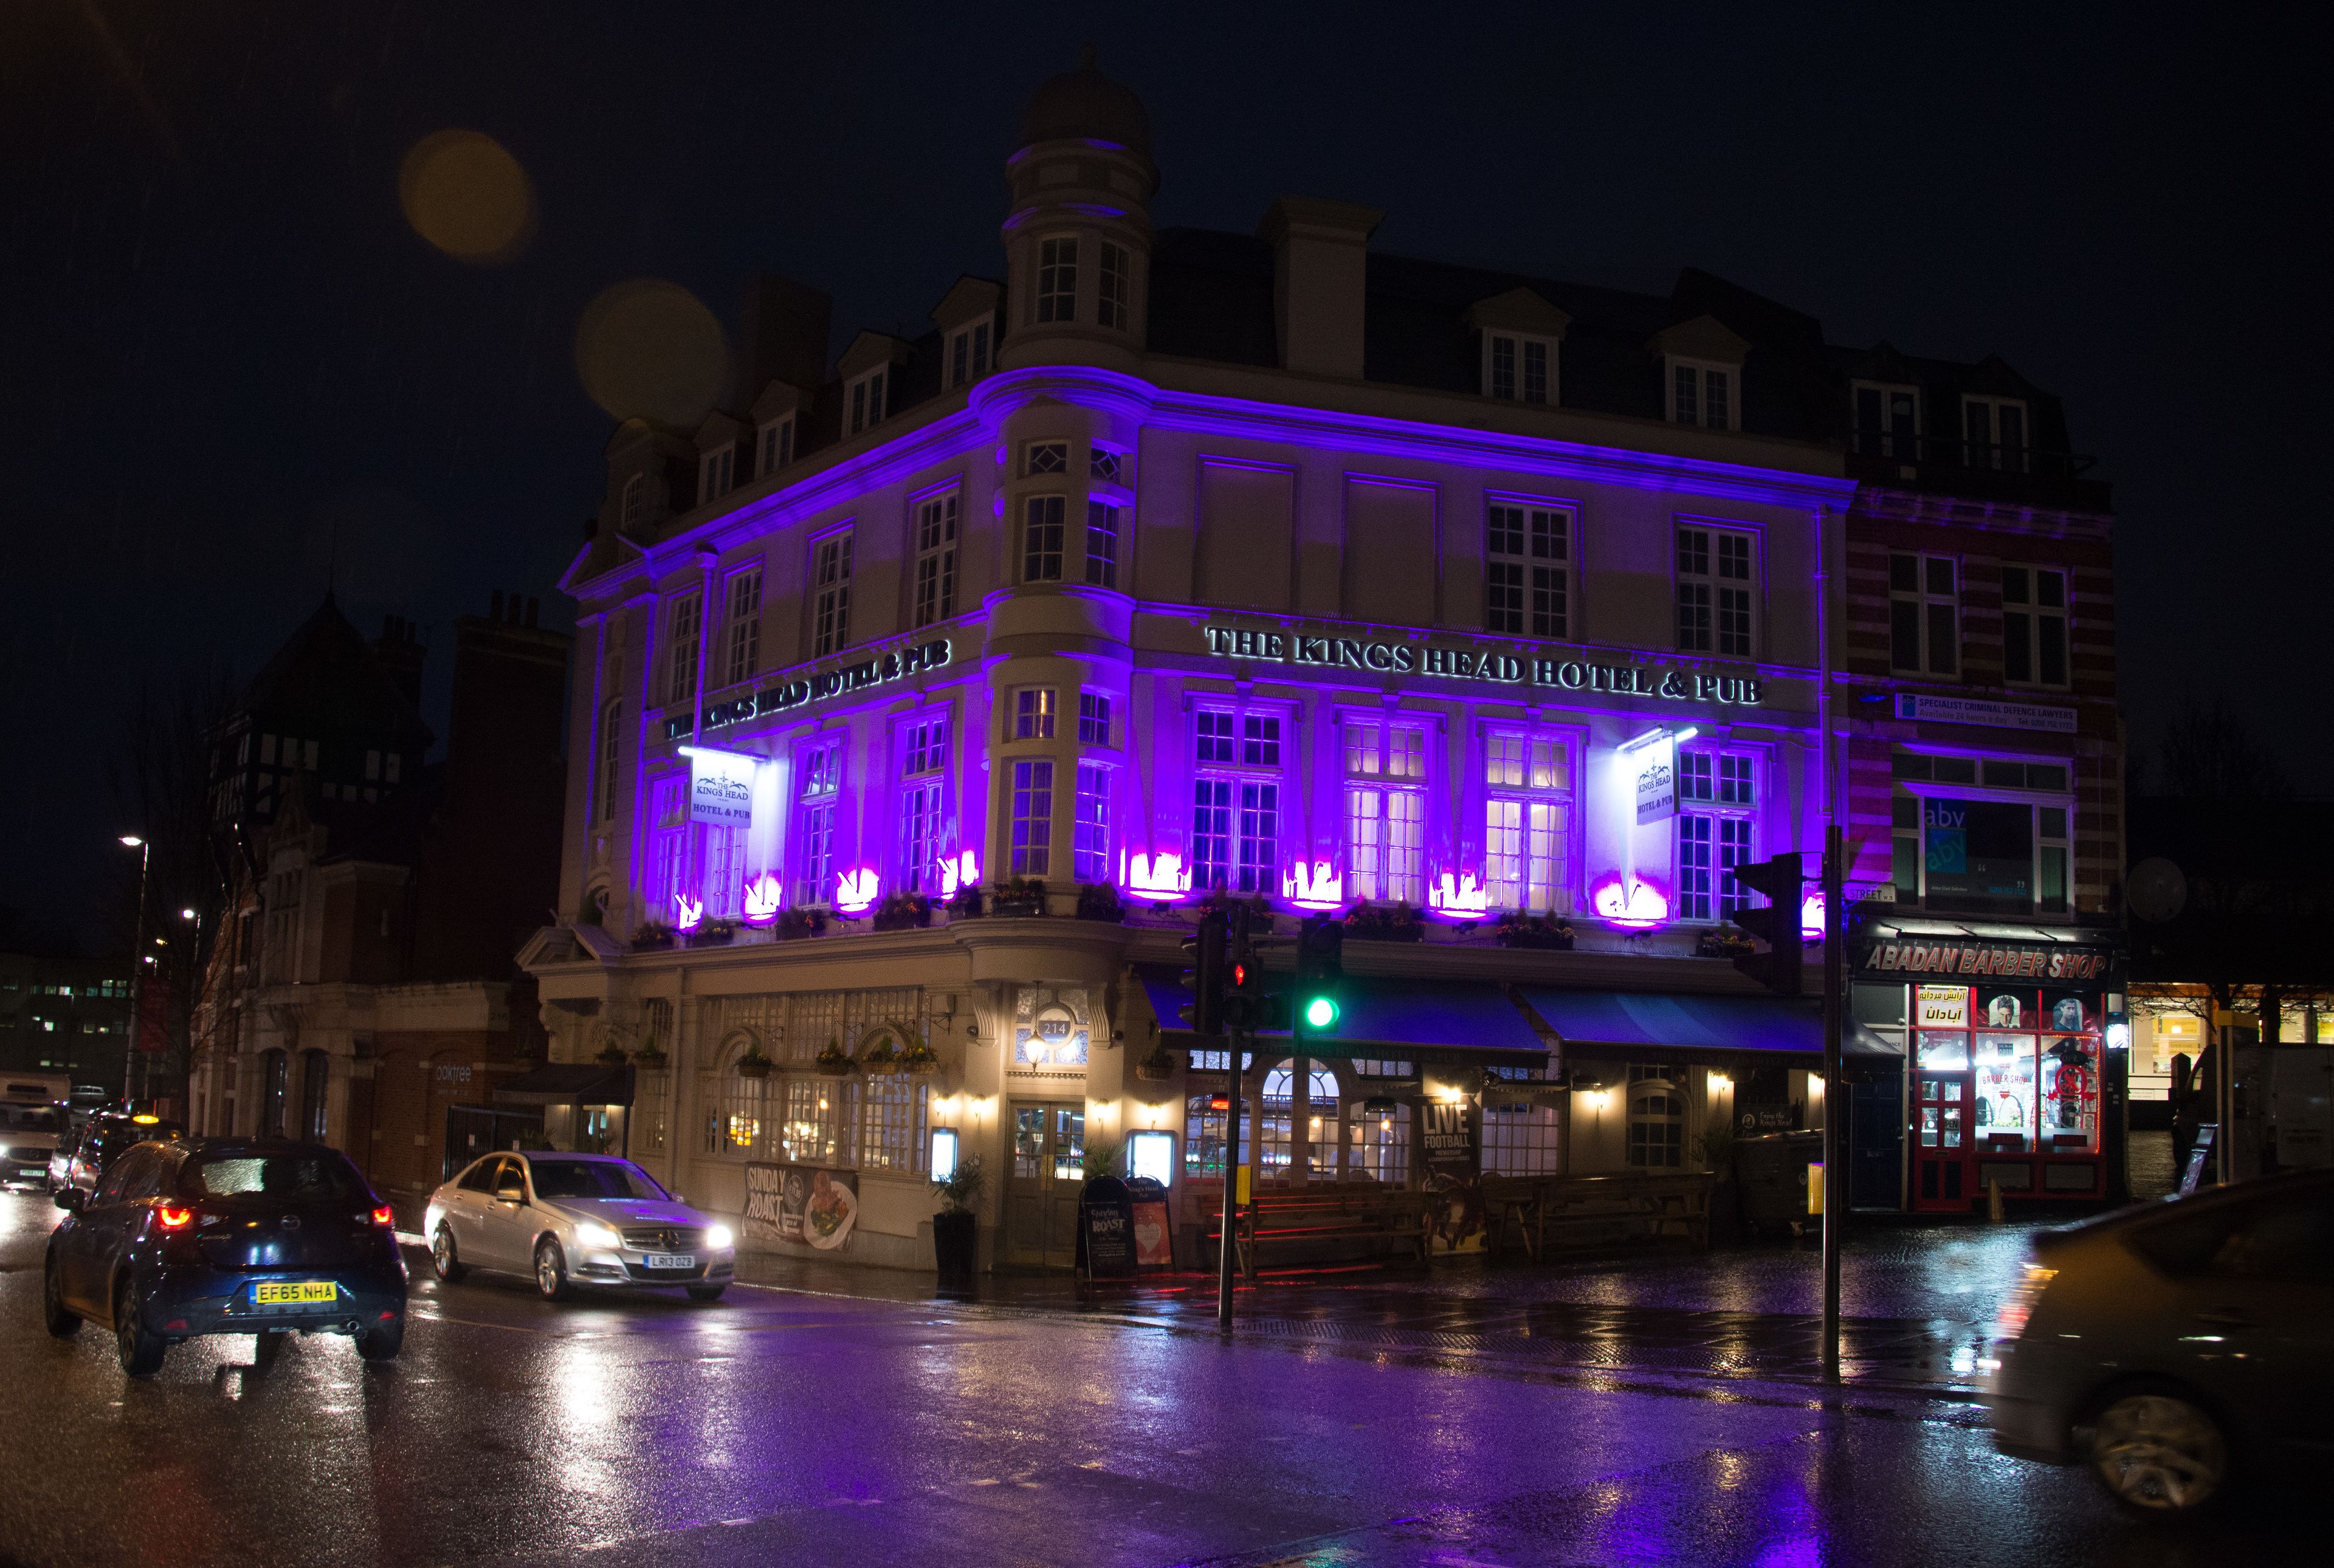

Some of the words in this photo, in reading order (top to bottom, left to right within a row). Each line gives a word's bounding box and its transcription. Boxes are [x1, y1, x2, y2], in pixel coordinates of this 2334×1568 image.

[881, 653, 902, 681] &
[903, 638, 952, 675] PUB
[1206, 625, 1285, 661] THE
[1295, 634, 1415, 672] KINGS
[1422, 647, 1527, 683] HEAD
[1534, 658, 1656, 696] HOTEL
[1661, 670, 1689, 698] &
[1695, 673, 1764, 705] PUB
[1919, 698, 1962, 710] SPECIALIST
[1964, 702, 2002, 714] CRIMINAL
[2003, 706, 2036, 717] DEFENCE
[2038, 710, 2073, 720] LAWYERS
[1919, 709, 1954, 720] Available
[1956, 712, 1964, 720] 24
[697, 786, 723, 797] KINGS
[725, 790, 748, 800] HEAD
[1639, 780, 1654, 793] KINGS
[1656, 775, 1671, 788] HEAD
[693, 803, 722, 816] HOTEL
[725, 808, 731, 816] &
[734, 810, 750, 819] PUB
[1637, 802, 1656, 814] HOTEL
[1656, 799, 1661, 808] &
[1662, 795, 1673, 805] PUB
[1850, 889, 1882, 900] STREET
[1865, 944, 1958, 973] ABADAN
[1958, 948, 2048, 977] BARBER
[2048, 954, 2107, 979] SHOP
[1044, 1022, 1066, 1034] 214
[437, 1064, 471, 1085] oaktree
[1982, 1075, 2008, 1084] BARBER
[2010, 1075, 2028, 1085] SHOP
[1422, 1104, 1469, 1134] LIVE
[1423, 1134, 1470, 1149] FOOTBALL
[748, 1166, 785, 1194] SUNDAY
[747, 1191, 783, 1225] ROAST
[1092, 1218, 1126, 1233] ROAST
[260, 1285, 299, 1300] EF65
[305, 1284, 332, 1298] NHA
